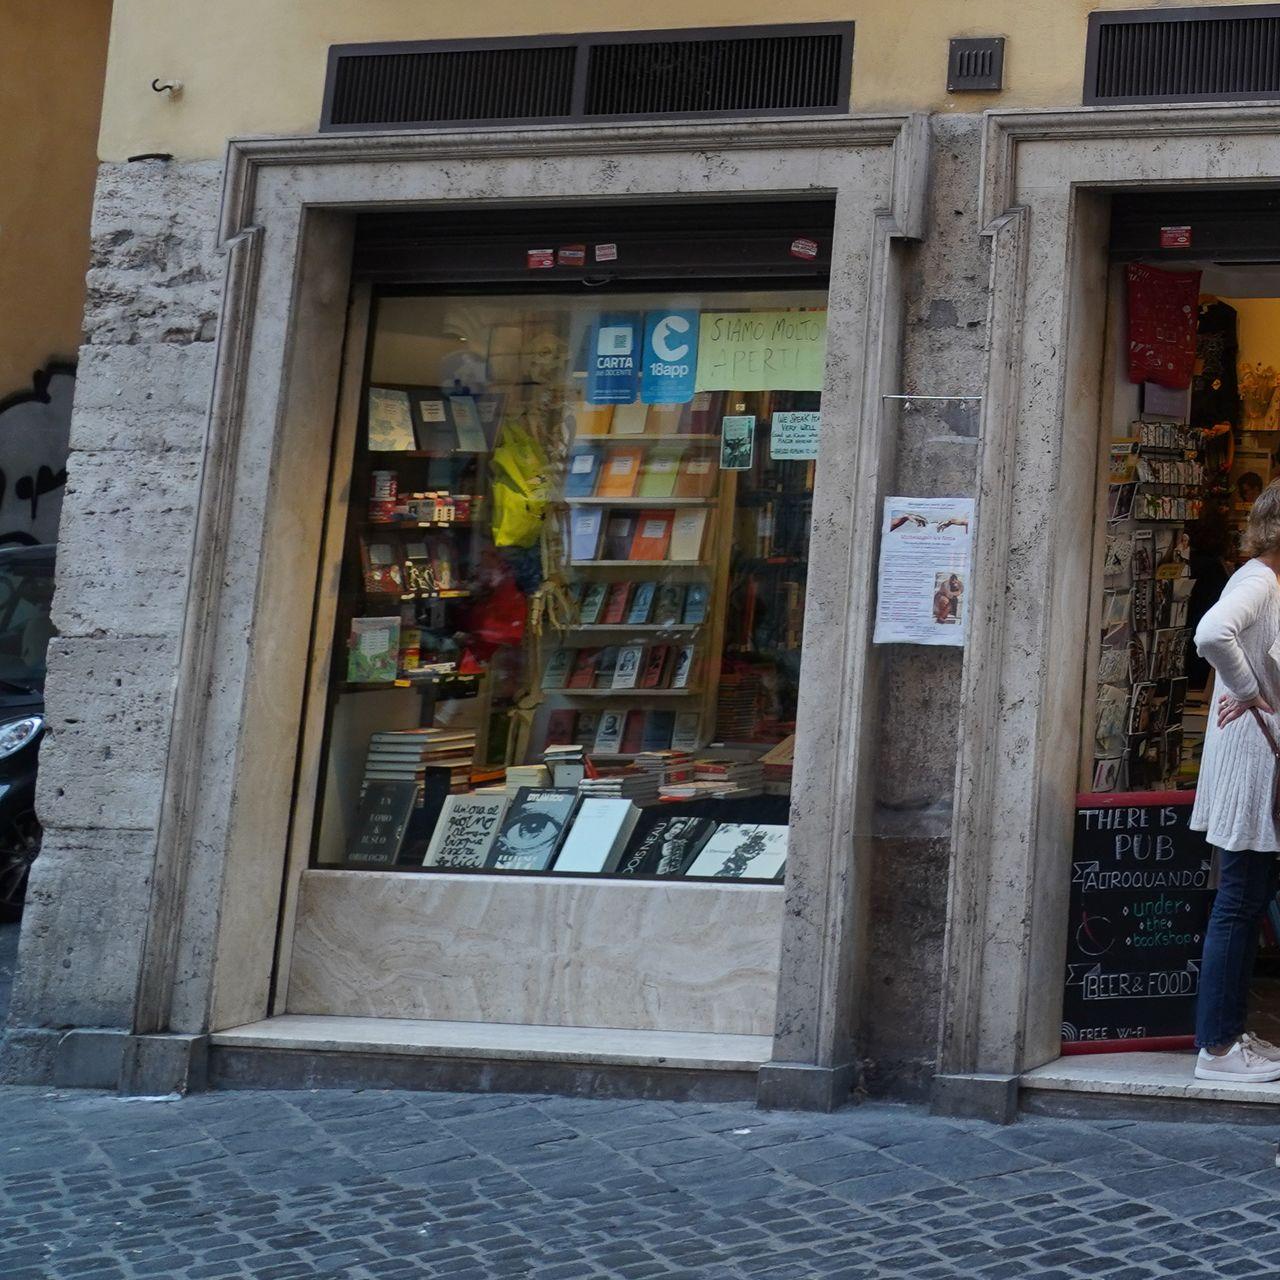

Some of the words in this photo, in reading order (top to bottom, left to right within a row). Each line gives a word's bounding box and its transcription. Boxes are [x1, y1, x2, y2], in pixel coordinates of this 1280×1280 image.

[711, 318, 764, 341] SIAMO
[771, 318, 822, 341] MOLTO
[597, 357, 633, 369] CARTA
[650, 363, 689, 378] 18app
[1078, 808, 1149, 830] THERE
[1160, 806, 1178, 827] IS
[1115, 833, 1175, 861] PUB
[1133, 893, 1184, 917] under
[1146, 917, 1167, 931] the
[1087, 974, 1131, 998] BEER
[1132, 976, 1143, 993] &
[1148, 971, 1192, 995] FOOD
[1079, 1027, 1108, 1041] FREE
